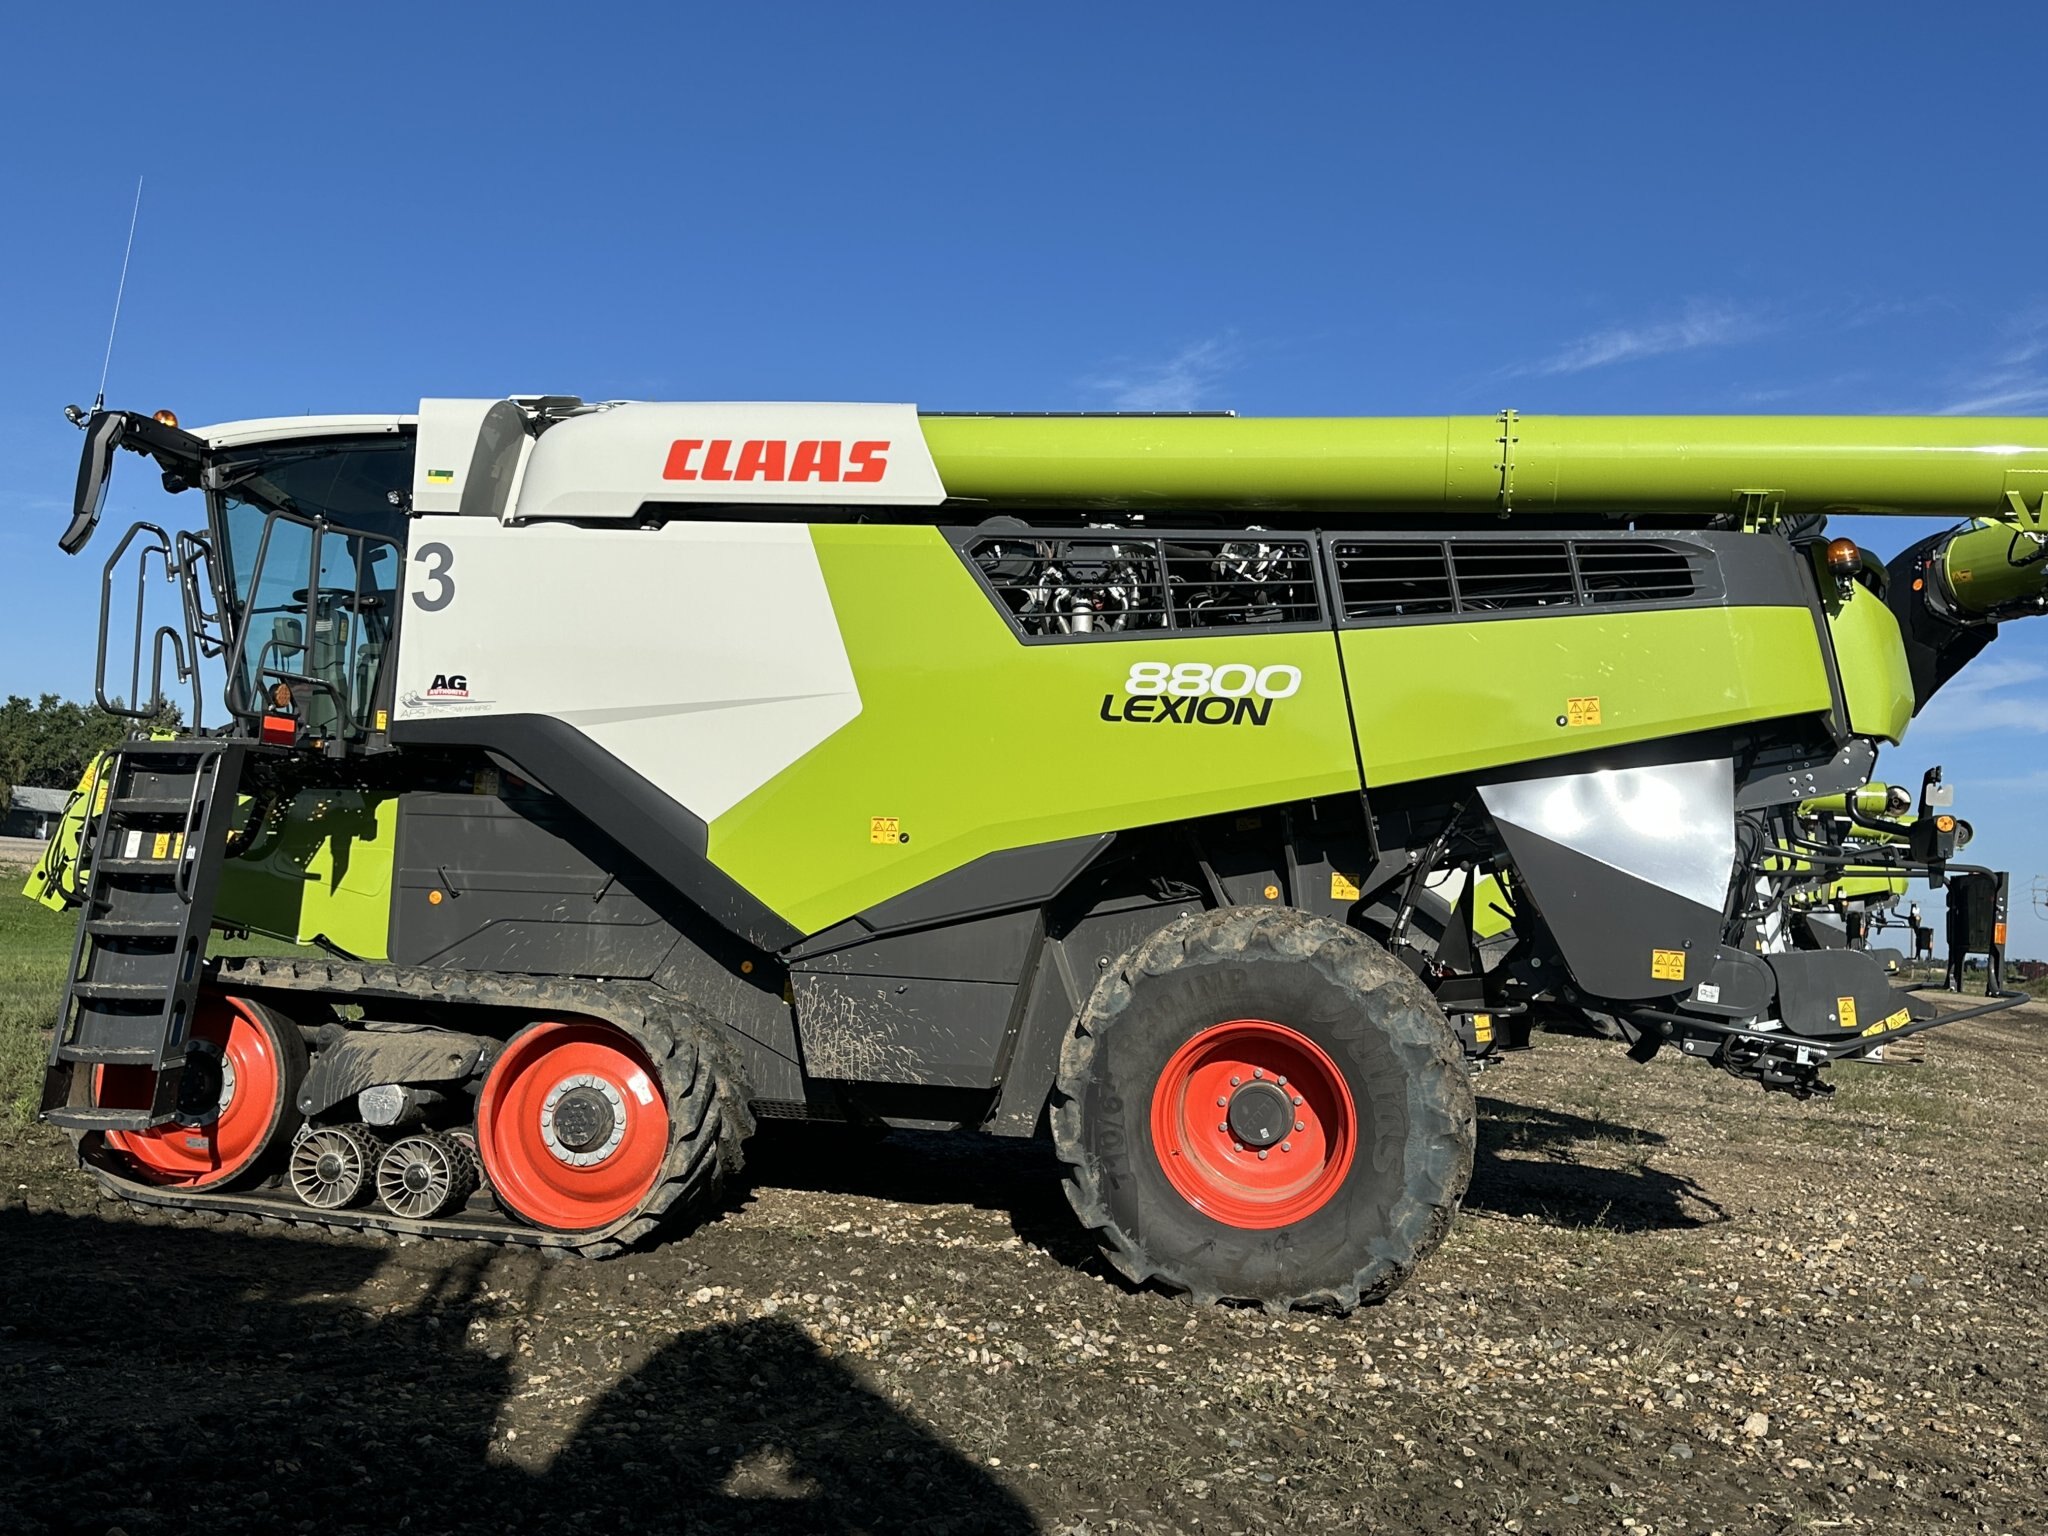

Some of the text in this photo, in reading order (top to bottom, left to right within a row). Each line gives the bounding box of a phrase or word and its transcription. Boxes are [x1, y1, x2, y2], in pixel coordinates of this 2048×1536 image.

[662, 439, 891, 482] CLAAS
[411, 541, 455, 612] 3
[429, 688, 467, 696] AUTHORITY
[430, 674, 467, 691] AG
[1125, 662, 1302, 699] 8800
[400, 709, 425, 718] APS
[1100, 694, 1273, 726] LEXION
